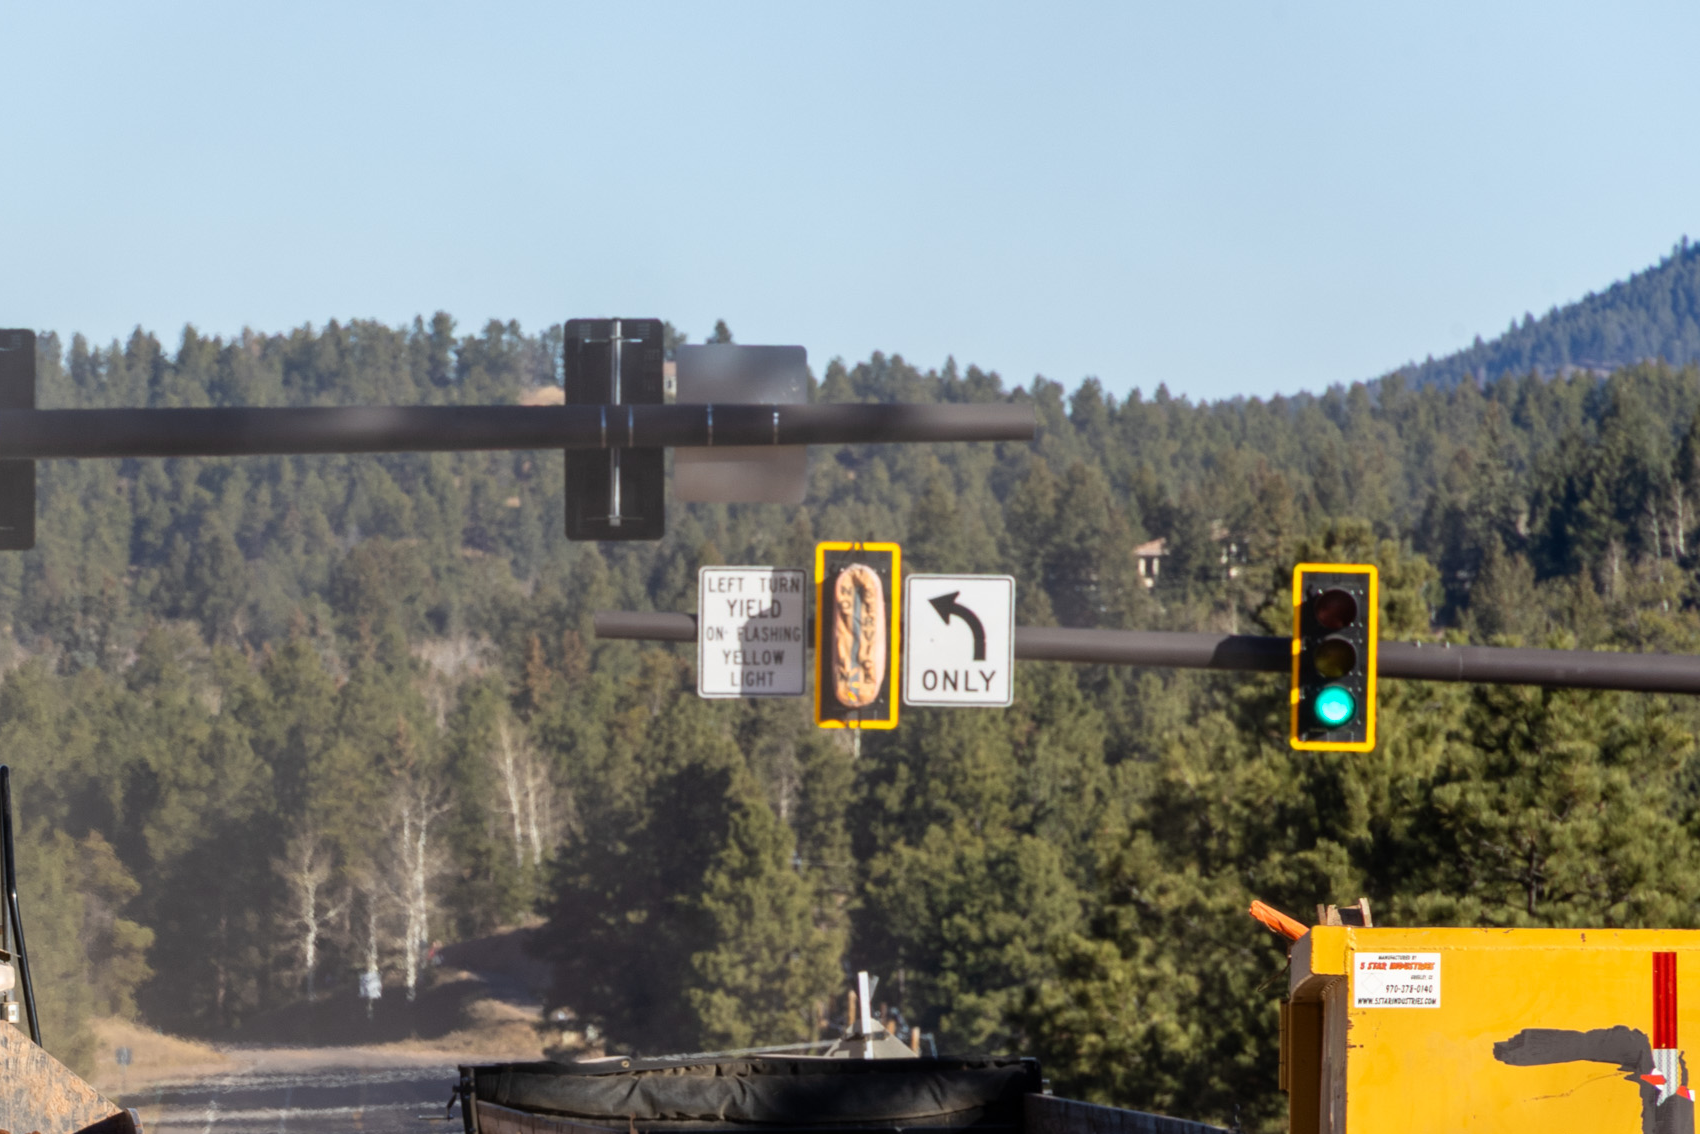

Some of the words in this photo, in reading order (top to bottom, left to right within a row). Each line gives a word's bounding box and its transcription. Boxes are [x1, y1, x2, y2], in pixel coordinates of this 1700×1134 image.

[708, 577, 744, 593] LEFT
[759, 577, 800, 593] TURN
[726, 599, 782, 619] YIELD
[706, 626, 724, 641] ON
[737, 626, 801, 642] FLASHING
[723, 650, 785, 666] YELLOW
[730, 671, 775, 687] LIGHT
[922, 669, 997, 693] ONLY
[1367, 962, 1387, 970] STAR
[1389, 962, 1435, 970] INDUSTRIES
